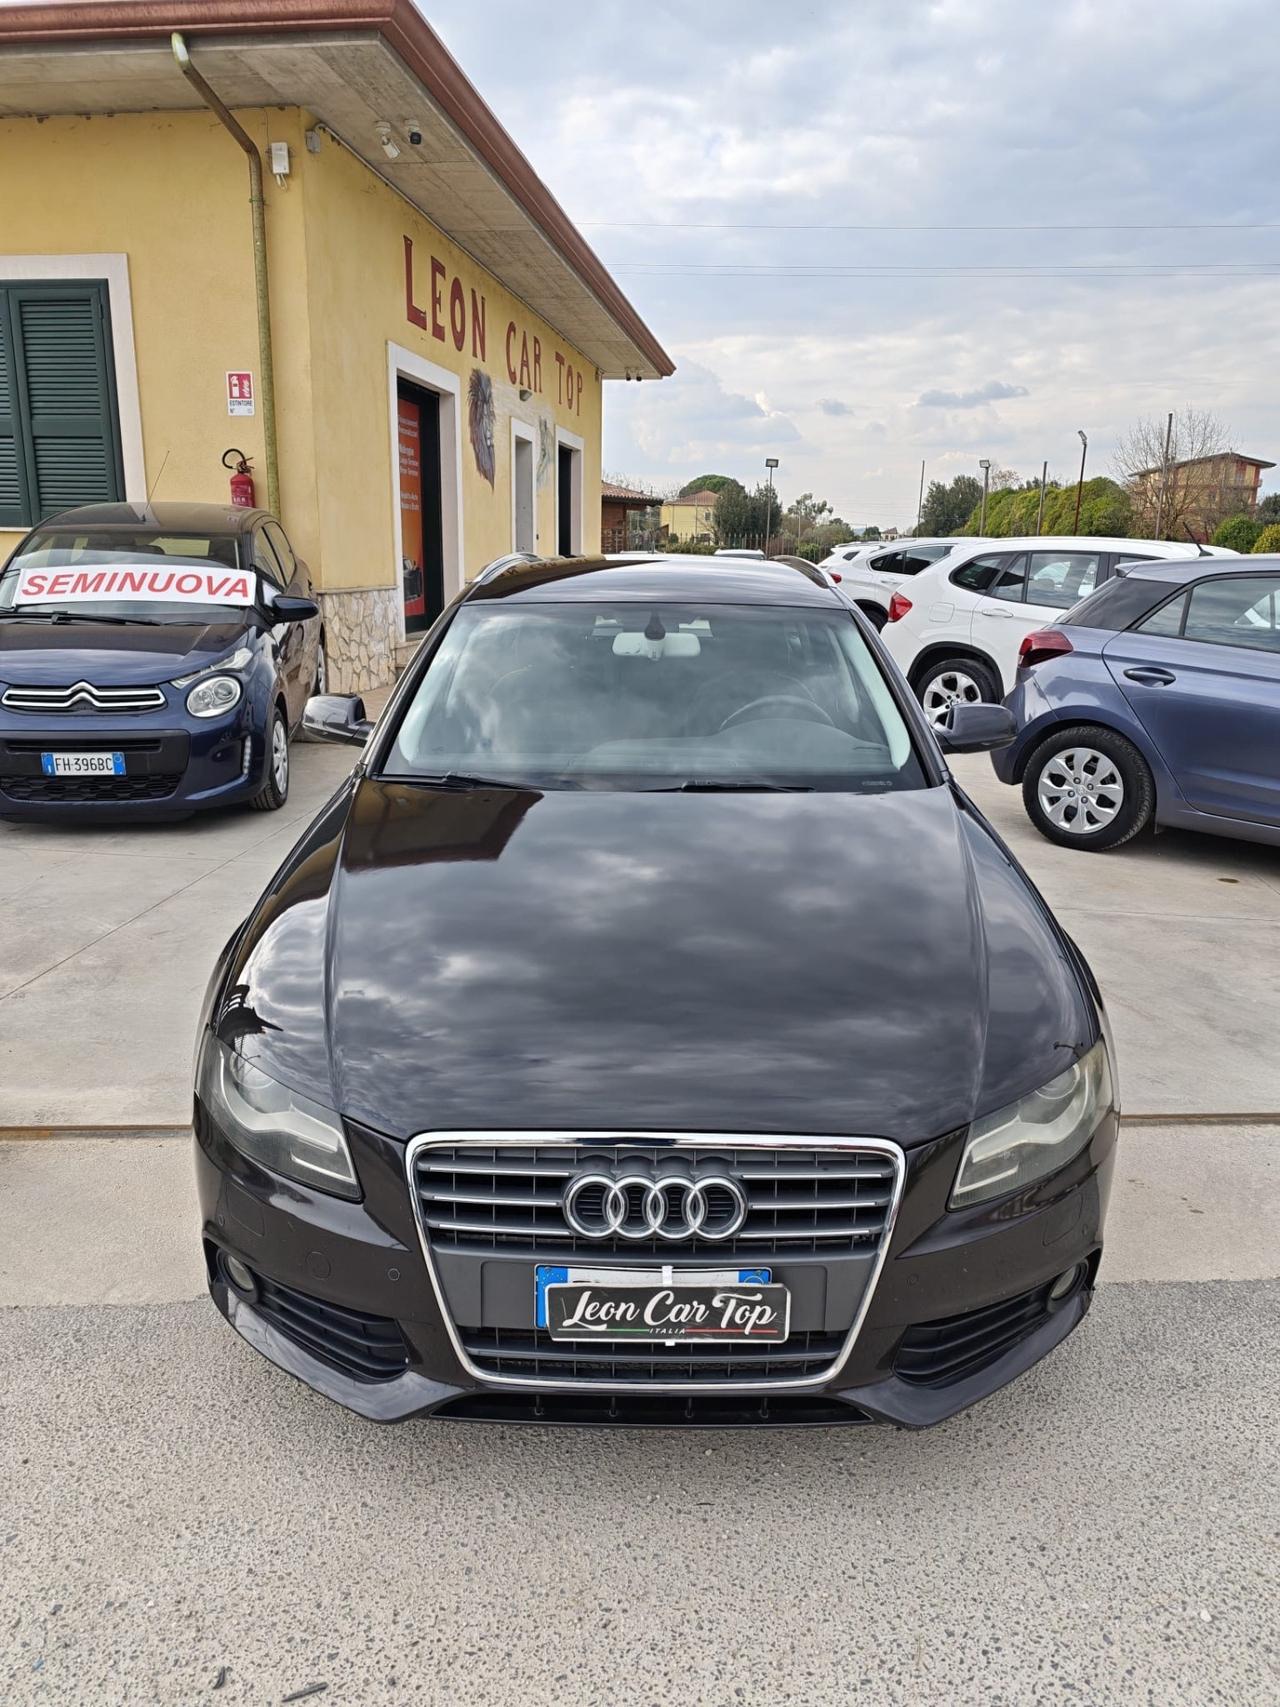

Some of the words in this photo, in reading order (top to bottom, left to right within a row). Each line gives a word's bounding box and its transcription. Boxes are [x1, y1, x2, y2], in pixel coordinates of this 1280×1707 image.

[403, 234, 486, 362] LEON
[506, 321, 542, 393] CAR
[555, 351, 583, 416] TOP
[22, 572, 249, 597] SEMINUOVA
[562, 1290, 640, 1331] Leon
[643, 1290, 709, 1326] Car
[712, 1293, 777, 1336] Top
[649, 1327, 686, 1335] ITALIA
